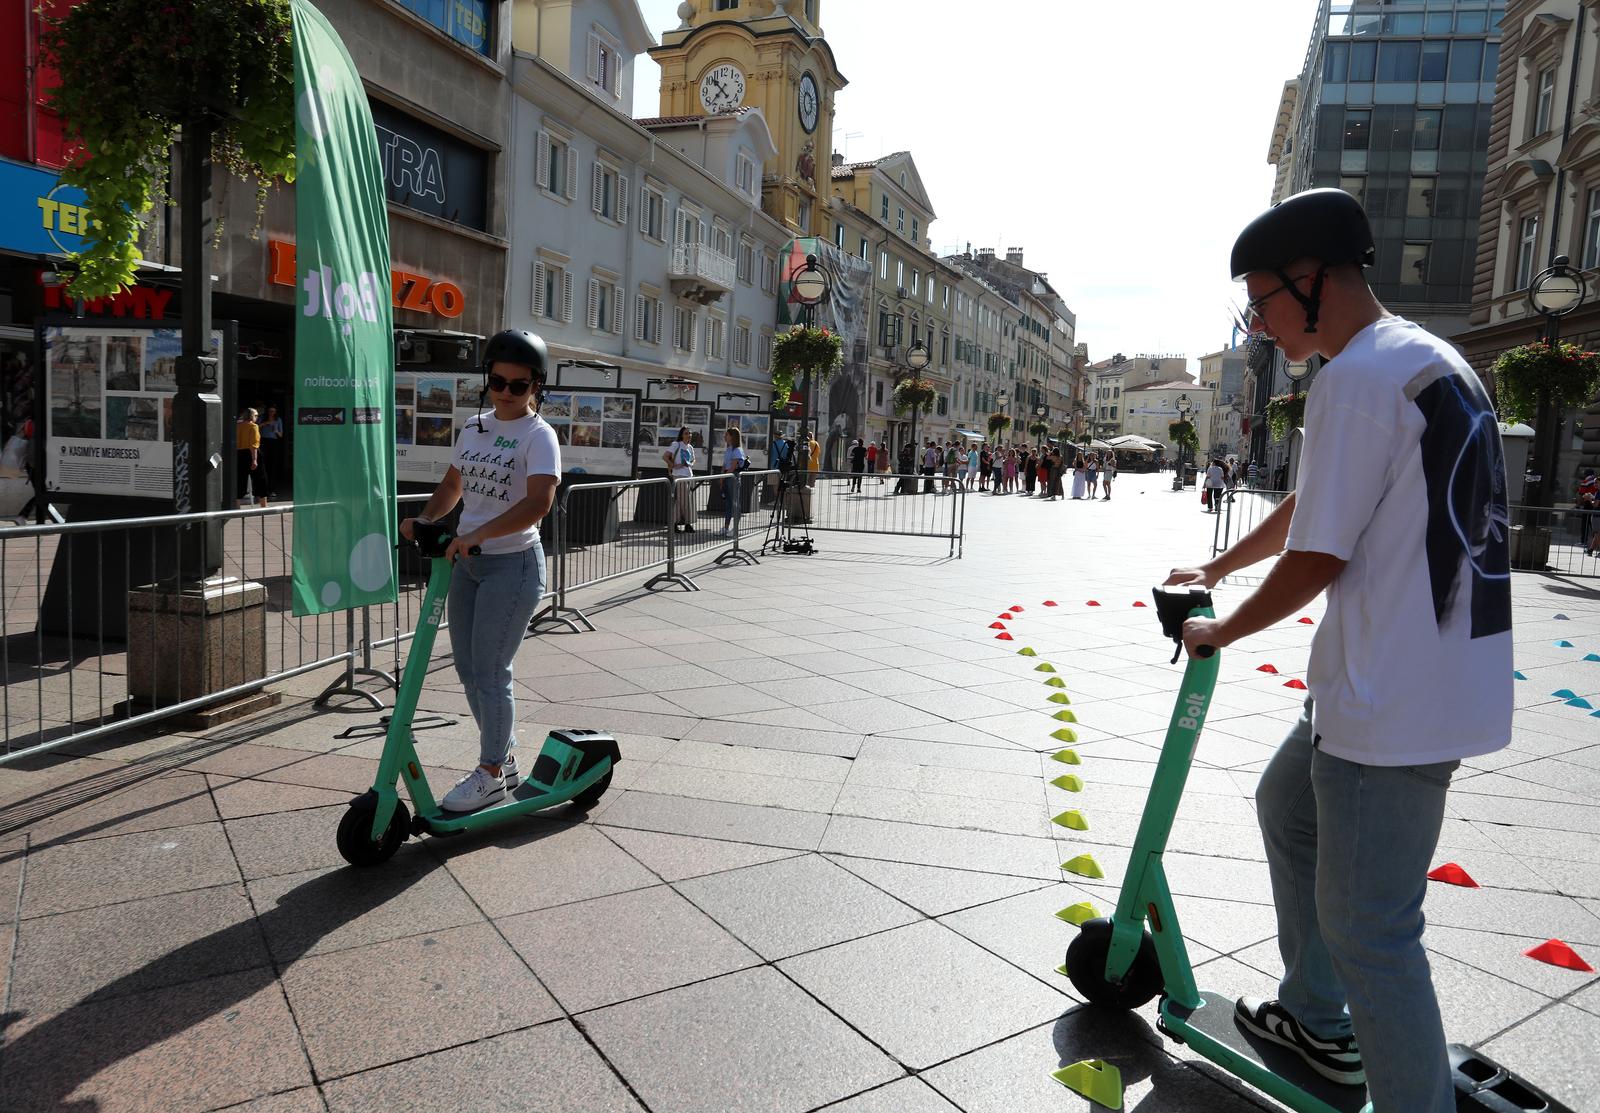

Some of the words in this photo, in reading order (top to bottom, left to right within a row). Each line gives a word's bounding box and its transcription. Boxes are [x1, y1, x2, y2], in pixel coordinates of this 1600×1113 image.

[721, 67, 728, 77] 12
[702, 87, 708, 96] 9
[737, 83, 743, 93] 3
[427, 598, 444, 625] Bolt
[1178, 693, 1205, 730] Bolt
